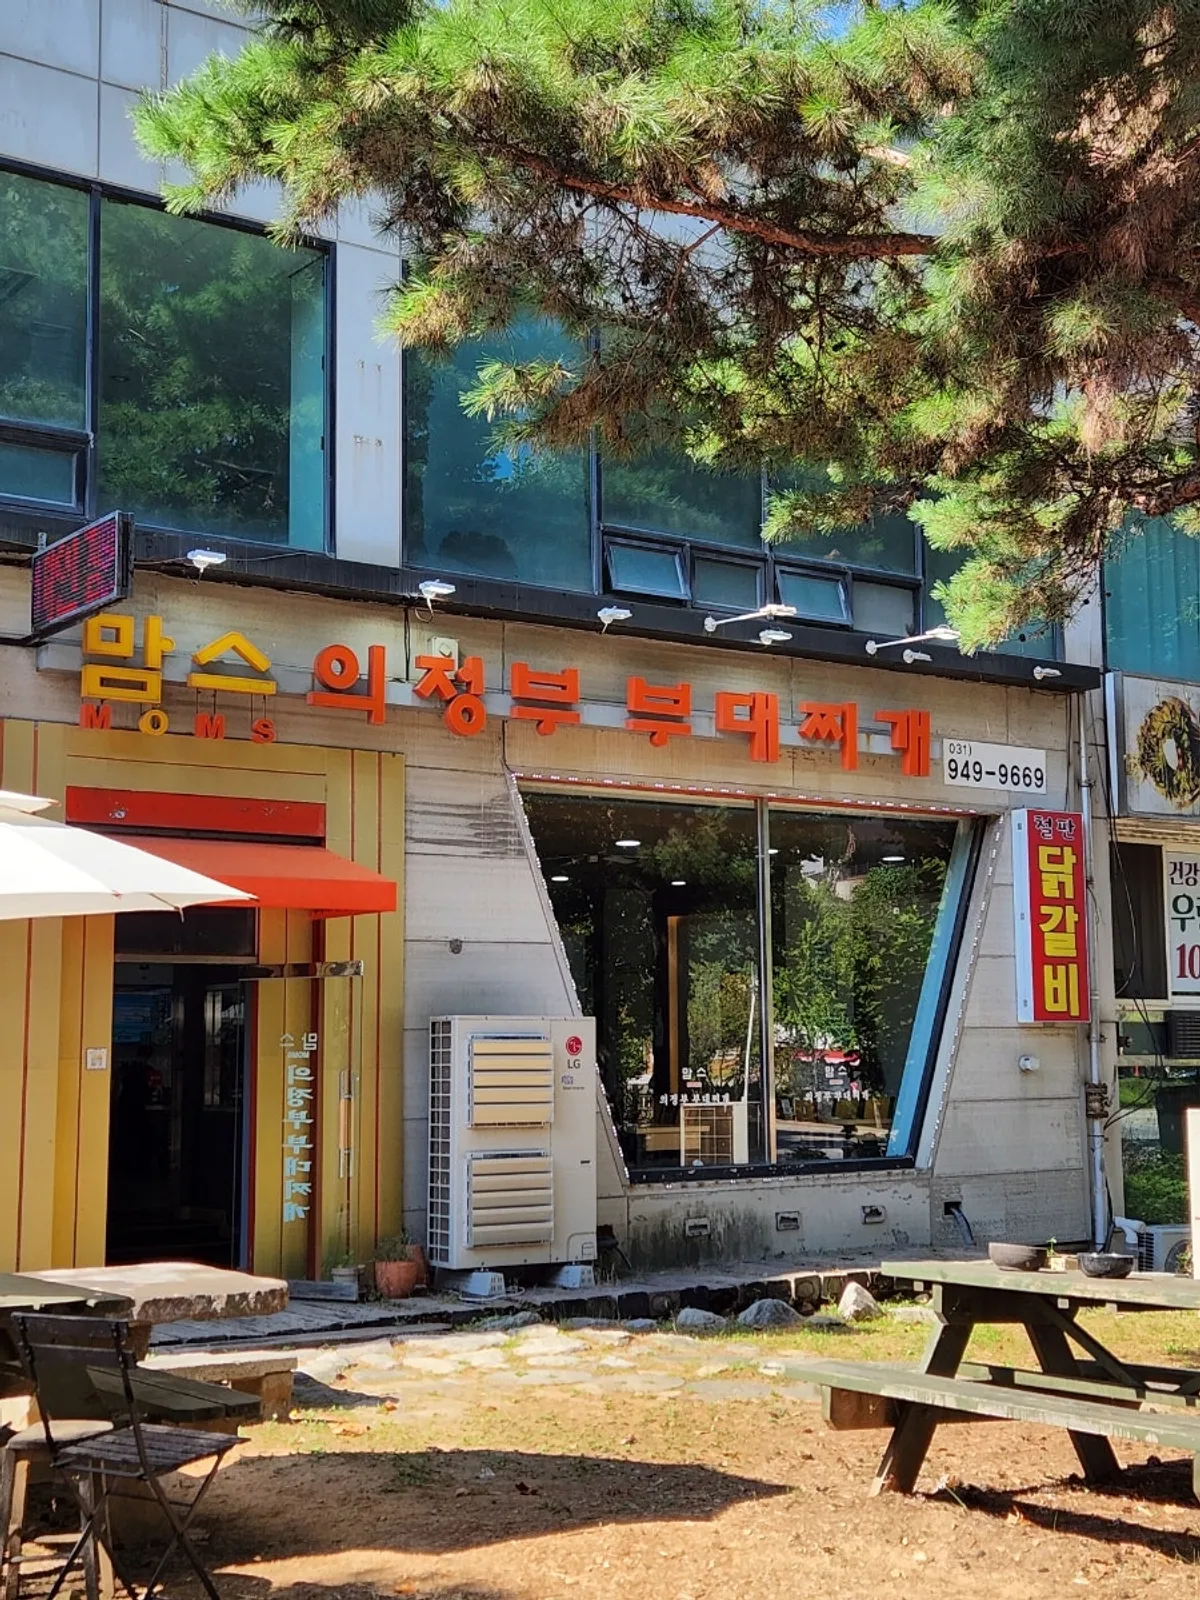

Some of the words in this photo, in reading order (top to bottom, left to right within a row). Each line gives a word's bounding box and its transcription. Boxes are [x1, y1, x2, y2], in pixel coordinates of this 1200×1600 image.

[81, 612, 276, 704] 맘스
[79, 702, 276, 745] MOMS
[948, 743, 972, 756] 031)
[947, 758, 1044, 788] 949-9669
[1034, 815, 1076, 841] 철판
[1171, 893, 1200, 933] 우
[1037, 844, 1080, 1018] 닭갈비
[567, 1059, 581, 1069] LG
